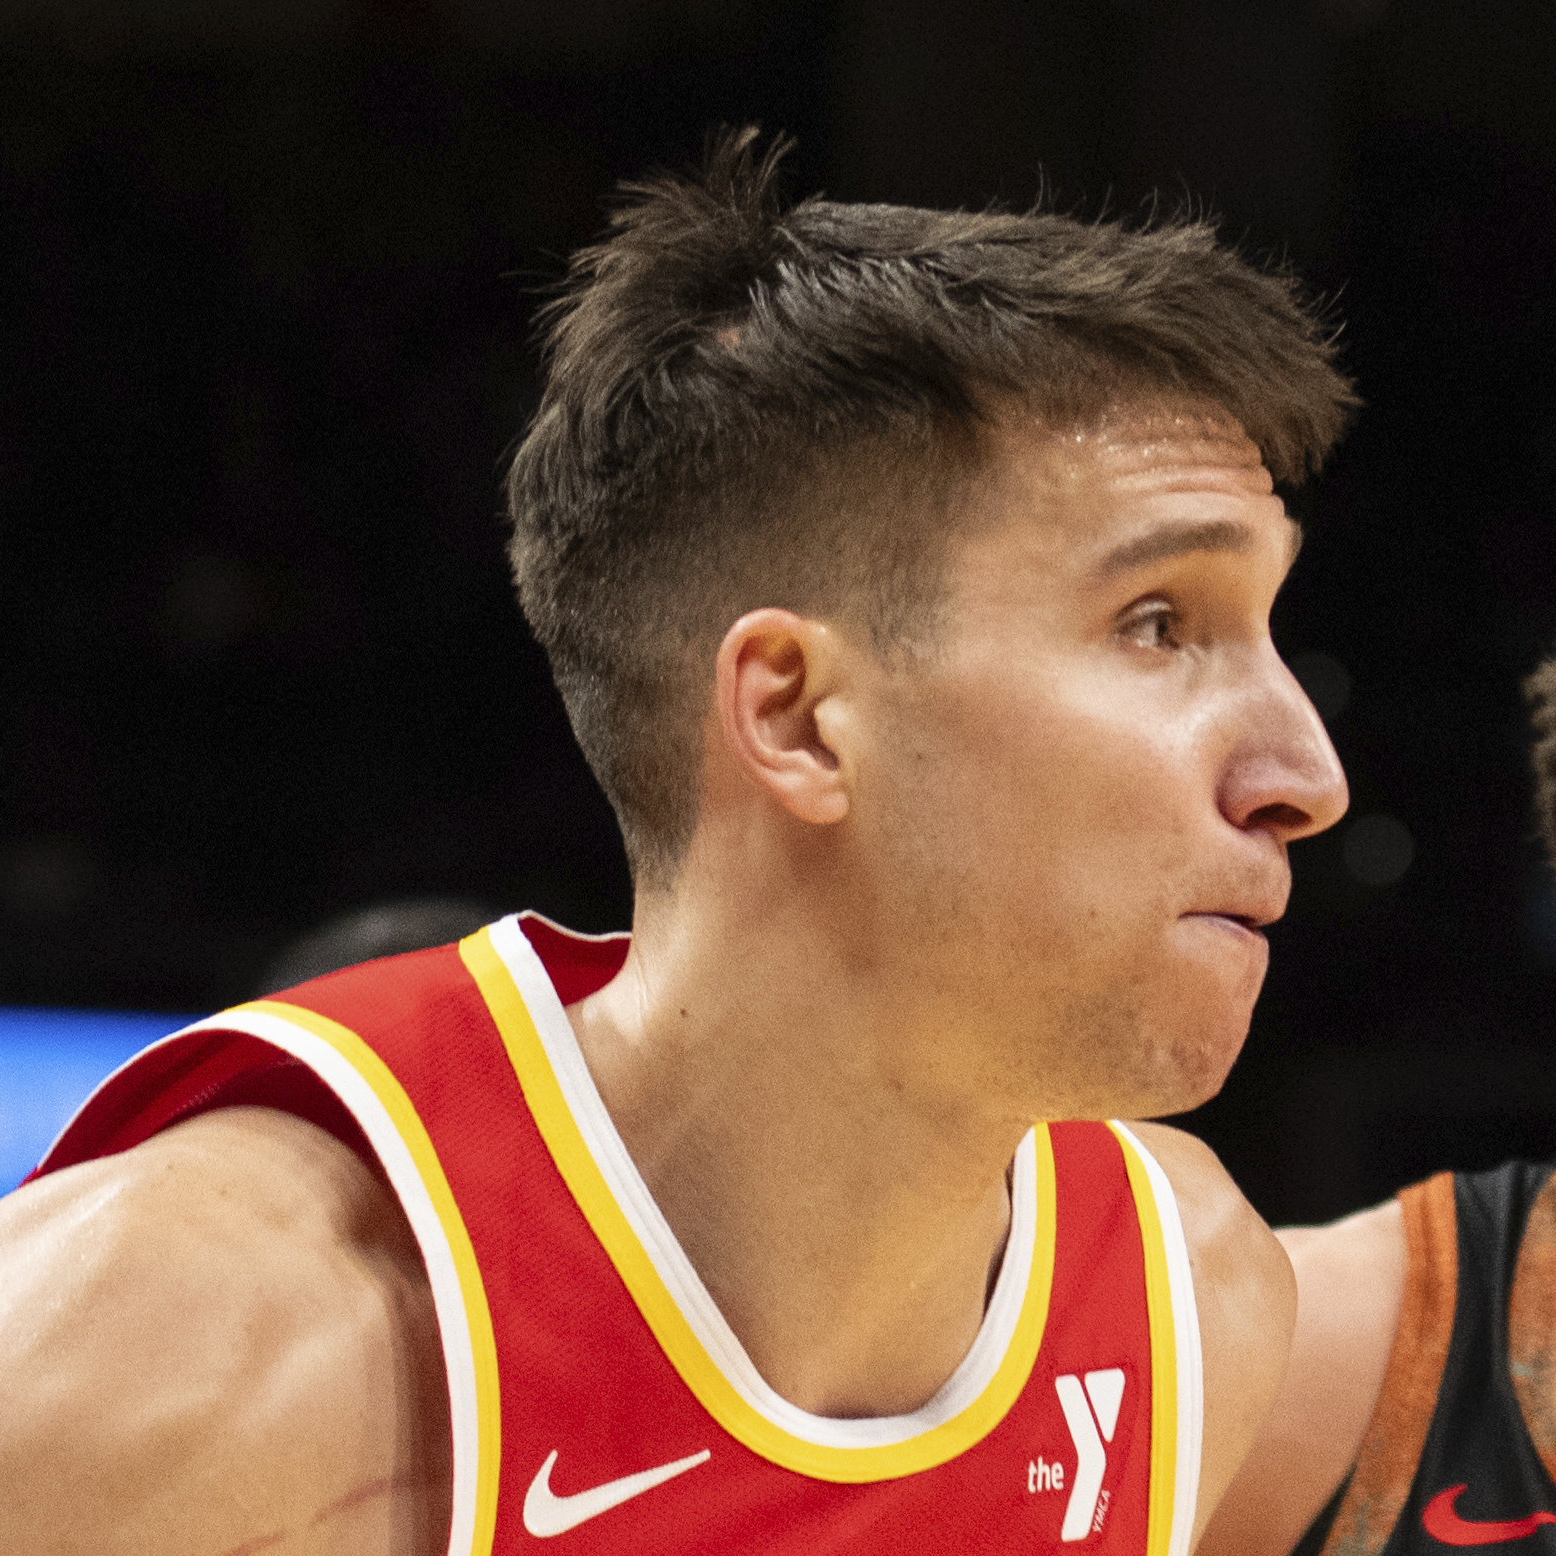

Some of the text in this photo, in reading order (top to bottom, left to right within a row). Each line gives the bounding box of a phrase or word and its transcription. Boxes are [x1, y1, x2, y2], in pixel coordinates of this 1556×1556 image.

[1028, 1368, 1126, 1542] the Y
[1092, 1489, 1111, 1534] YMCA
